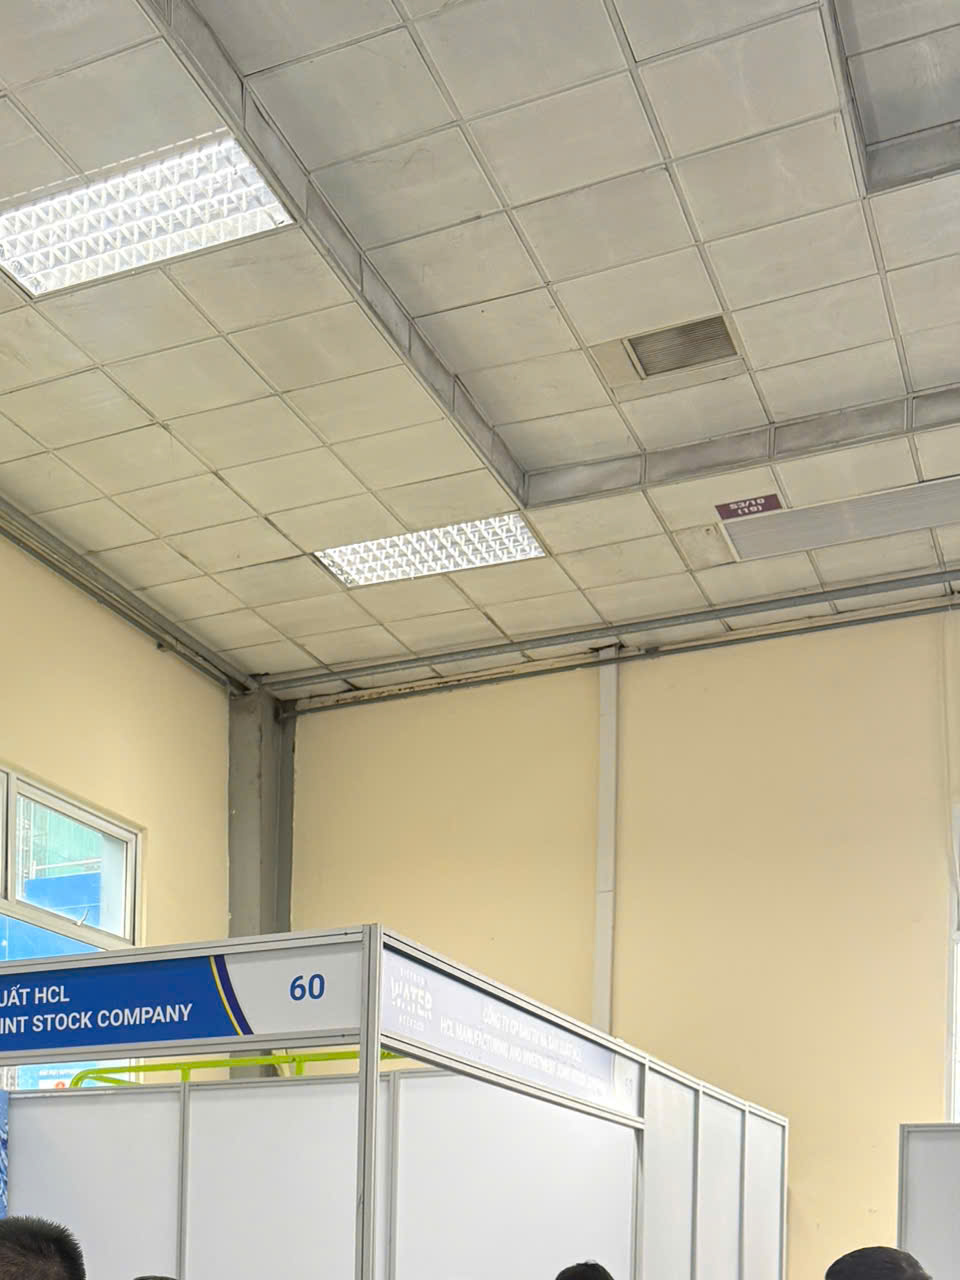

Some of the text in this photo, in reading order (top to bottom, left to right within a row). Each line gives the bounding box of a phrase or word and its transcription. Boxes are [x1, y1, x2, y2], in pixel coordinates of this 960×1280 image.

[34, 986, 70, 1005] HCL
[289, 973, 325, 1001] 60
[32, 1011, 93, 1032] STOCK
[96, 1003, 193, 1028] COMPANY
